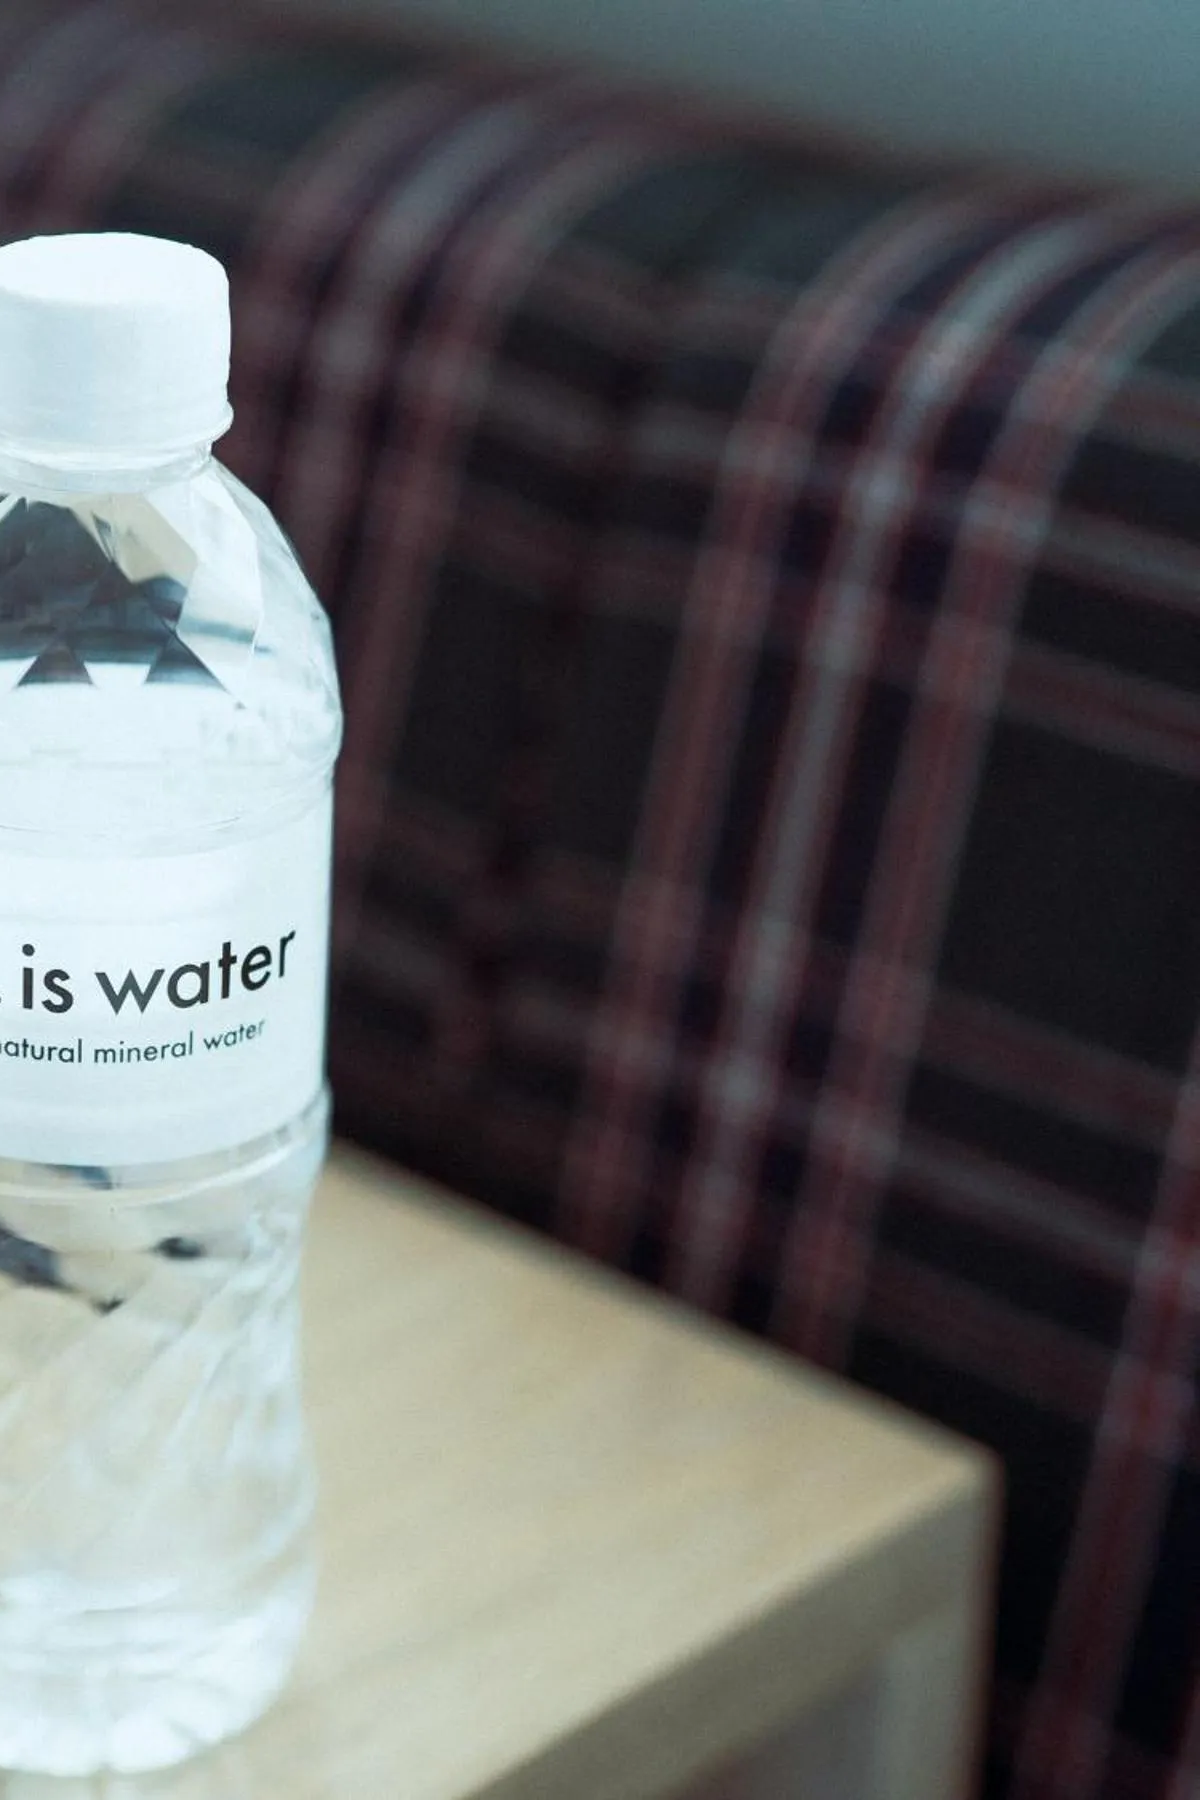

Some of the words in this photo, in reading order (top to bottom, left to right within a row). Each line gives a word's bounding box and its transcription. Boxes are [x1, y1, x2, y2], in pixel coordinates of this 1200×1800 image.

[21, 943, 74, 1014] is
[94, 930, 297, 1016] water
[93, 1030, 195, 1064] mineral
[203, 1019, 266, 1051] water
